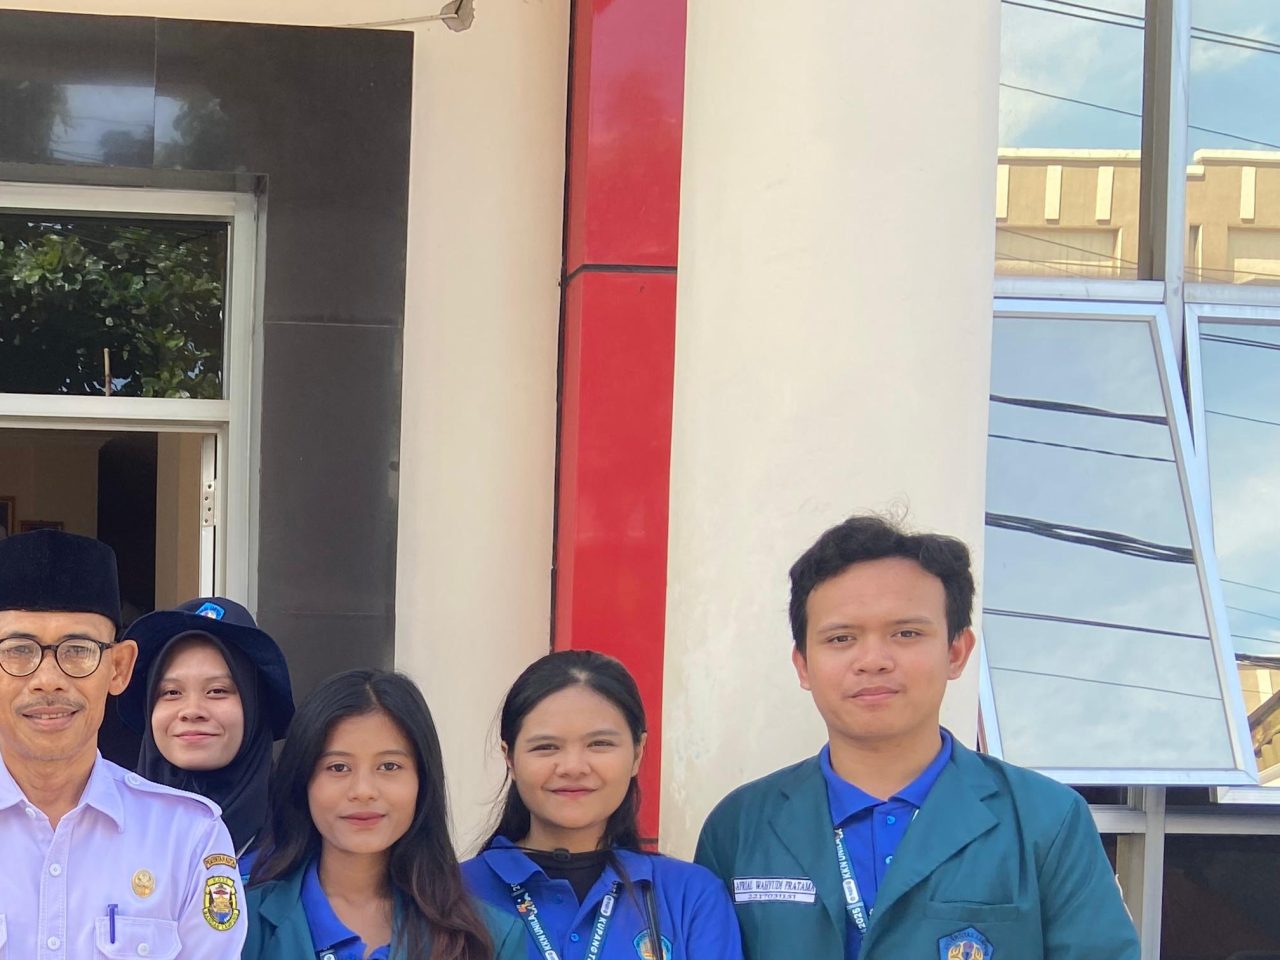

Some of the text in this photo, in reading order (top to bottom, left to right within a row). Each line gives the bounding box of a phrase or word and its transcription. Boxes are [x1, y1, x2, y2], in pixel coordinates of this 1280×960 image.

[528, 915, 551, 951] KKN UNILA
[590, 916, 607, 953] KUPANG
[852, 907, 866, 929] 2025
